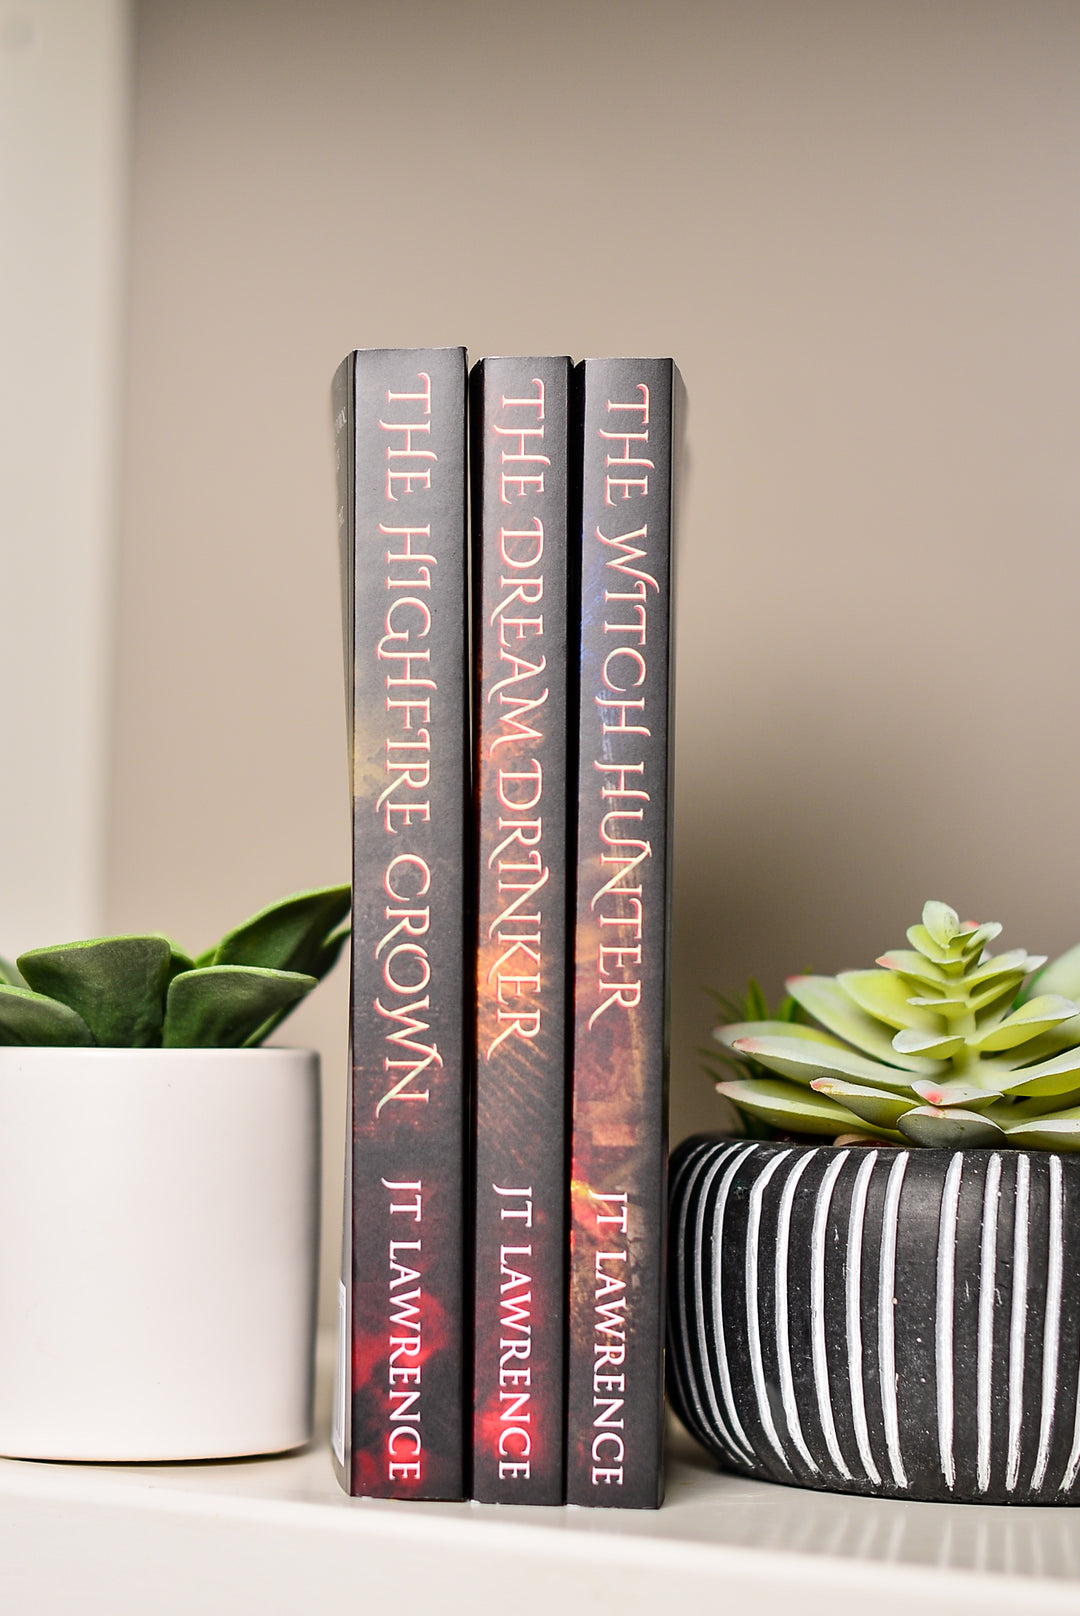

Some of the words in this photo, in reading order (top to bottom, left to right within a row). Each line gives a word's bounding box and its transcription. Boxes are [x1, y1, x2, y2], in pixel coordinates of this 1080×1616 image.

[378, 372, 438, 502] THE
[492, 378, 551, 505] THE
[599, 383, 655, 507] THE
[375, 523, 438, 834] HIGHFIRE
[488, 516, 549, 757] DREAM
[595, 523, 660, 737] WITCH
[374, 853, 443, 1119] CROWN
[486, 758, 549, 1062] DRINKER
[588, 759, 652, 1032] HUNTER
[381, 1177, 423, 1222] JT
[492, 1183, 533, 1228] JT
[589, 1189, 628, 1234] JT
[388, 1239, 423, 1481] LAWRENCE
[498, 1244, 533, 1480] LAWRENCE
[591, 1250, 627, 1487] LAWRENCE
